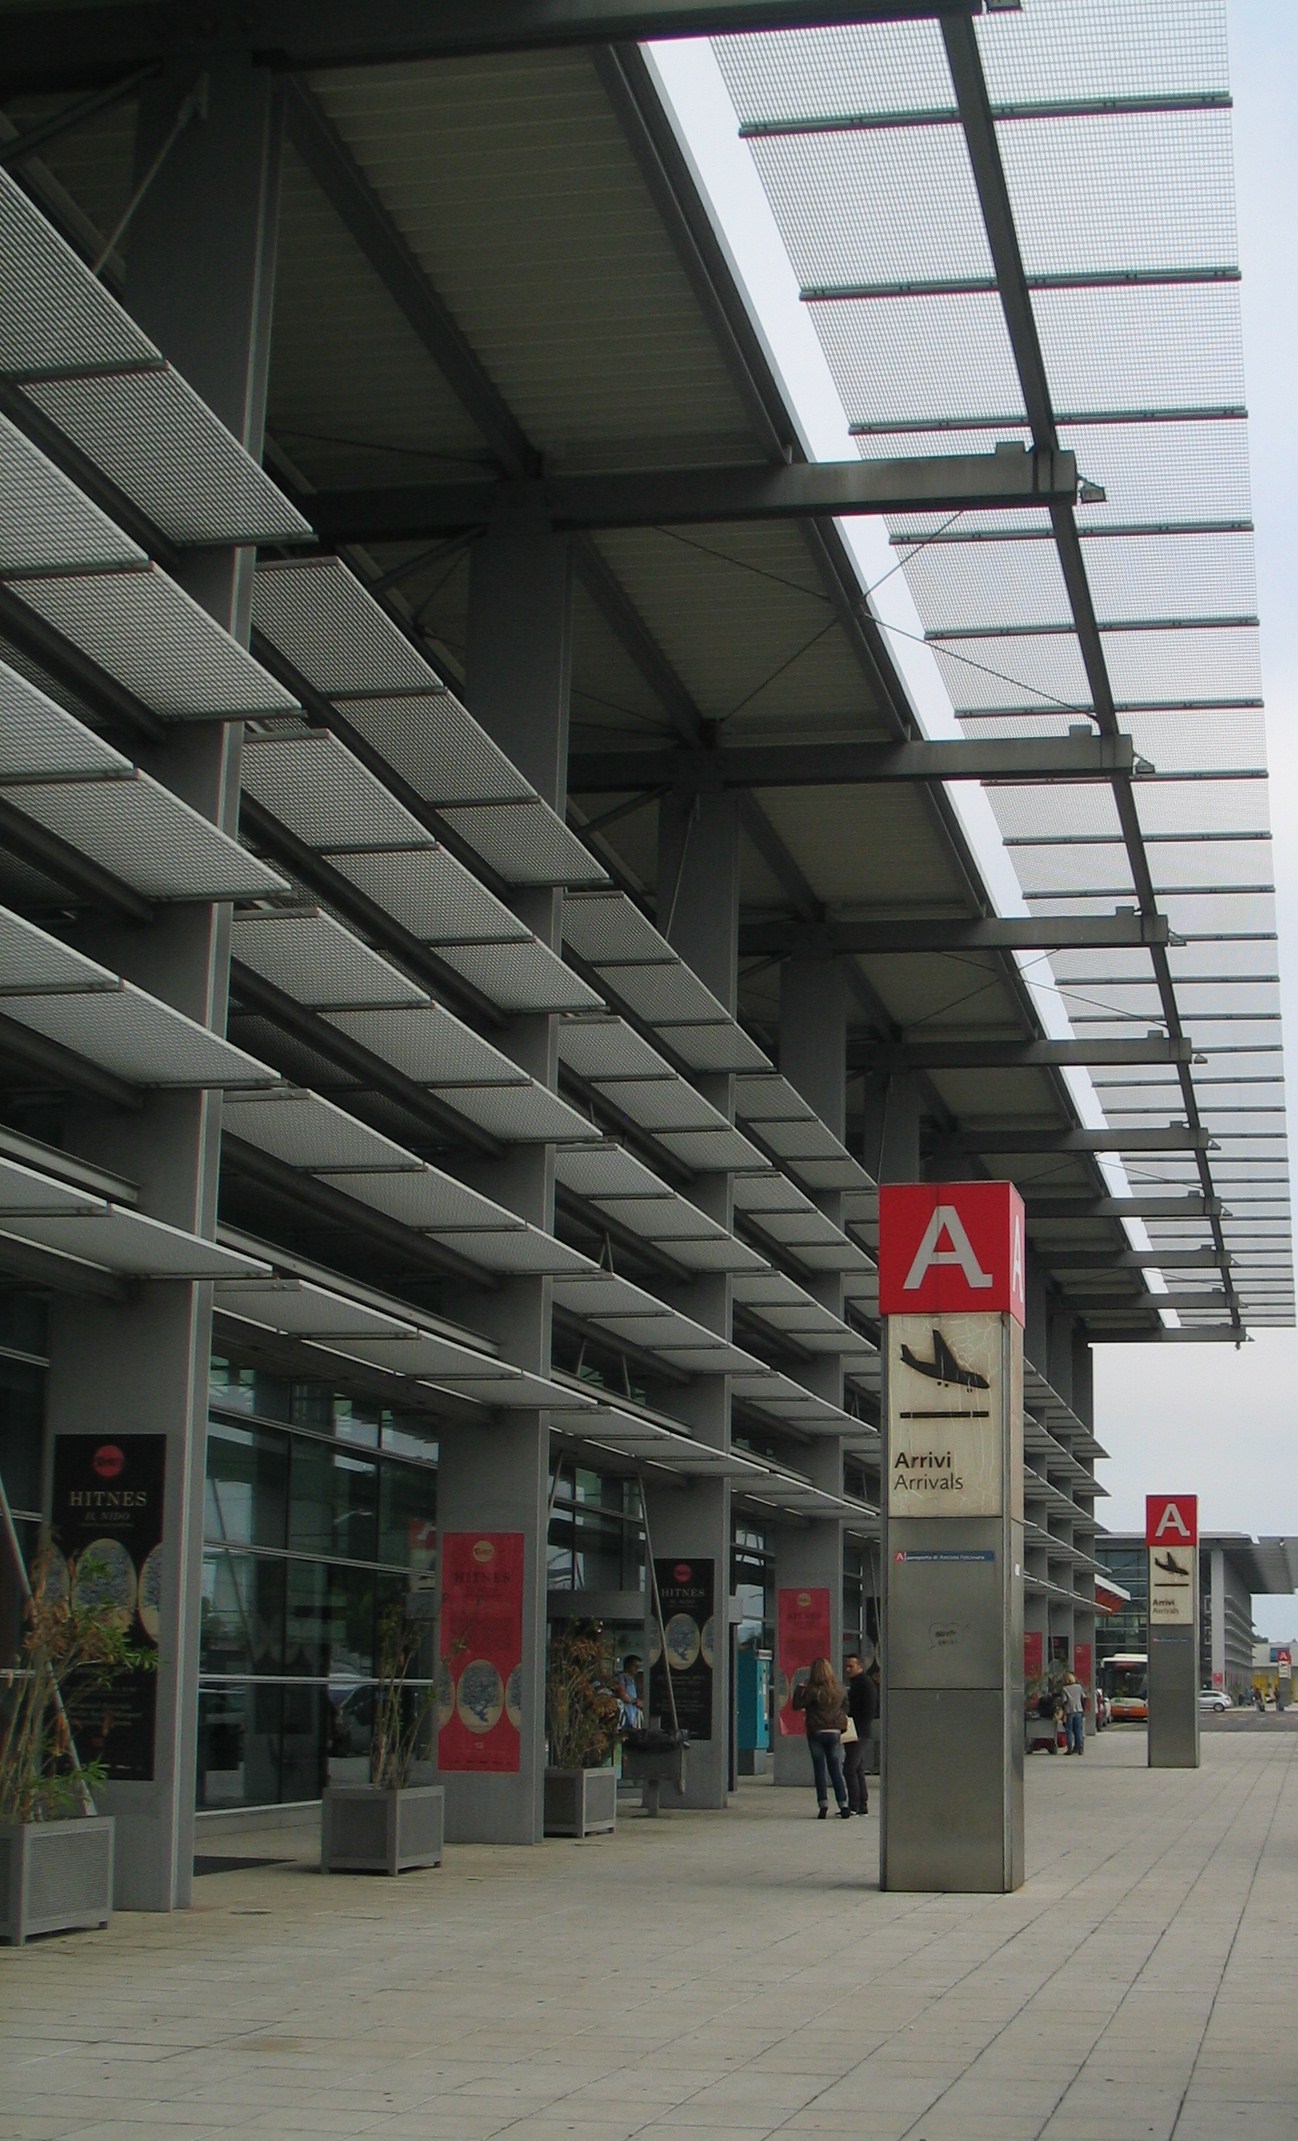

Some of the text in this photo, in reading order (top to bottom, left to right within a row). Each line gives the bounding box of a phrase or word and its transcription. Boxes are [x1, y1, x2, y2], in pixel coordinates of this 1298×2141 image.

[903, 1205, 993, 1289] A
[1012, 1214, 1025, 1304] A
[894, 1451, 951, 1469] Arrivi
[894, 1472, 964, 1490] Arrivals
[69, 1490, 148, 1507] HITNES
[1155, 1503, 1191, 1537] A
